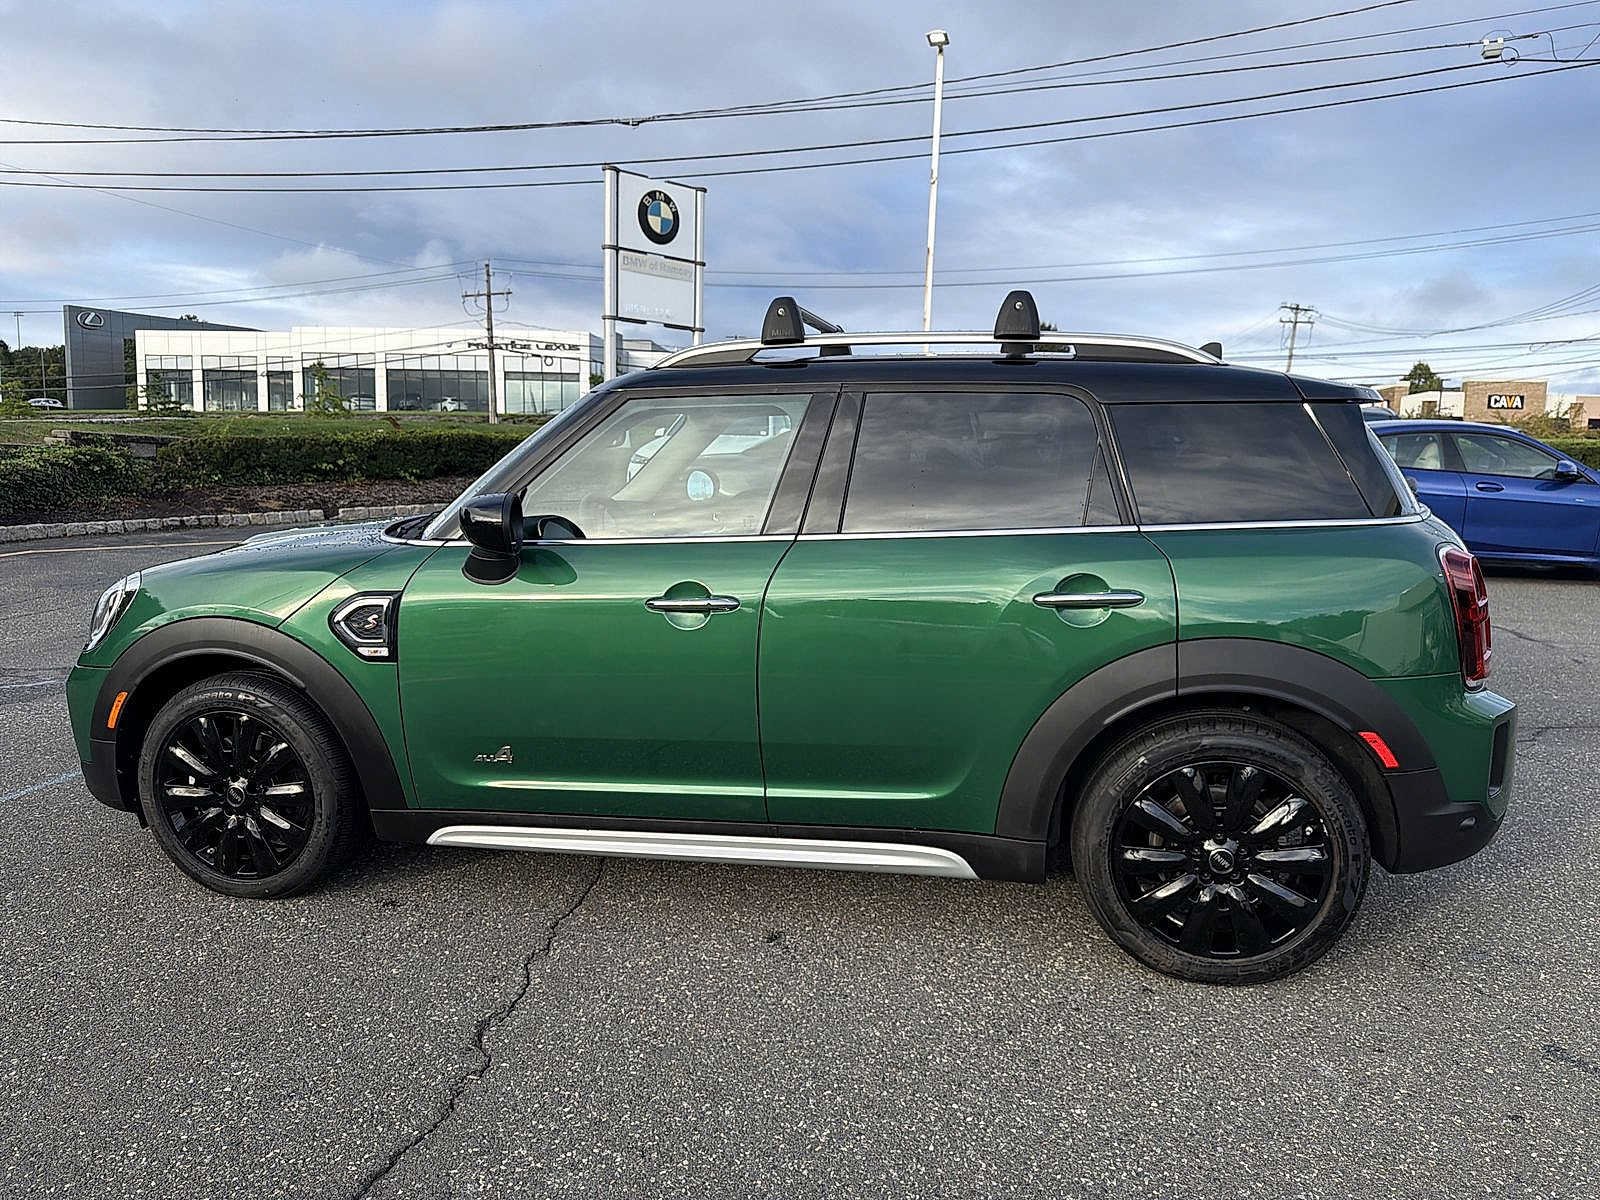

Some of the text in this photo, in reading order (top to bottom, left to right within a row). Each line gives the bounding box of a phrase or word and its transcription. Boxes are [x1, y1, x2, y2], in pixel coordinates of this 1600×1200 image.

[643, 192, 677, 212] BMW
[623, 255, 647, 268] BMW
[1490, 395, 1522, 408] CAVA
[1213, 853, 1231, 869] MINI
